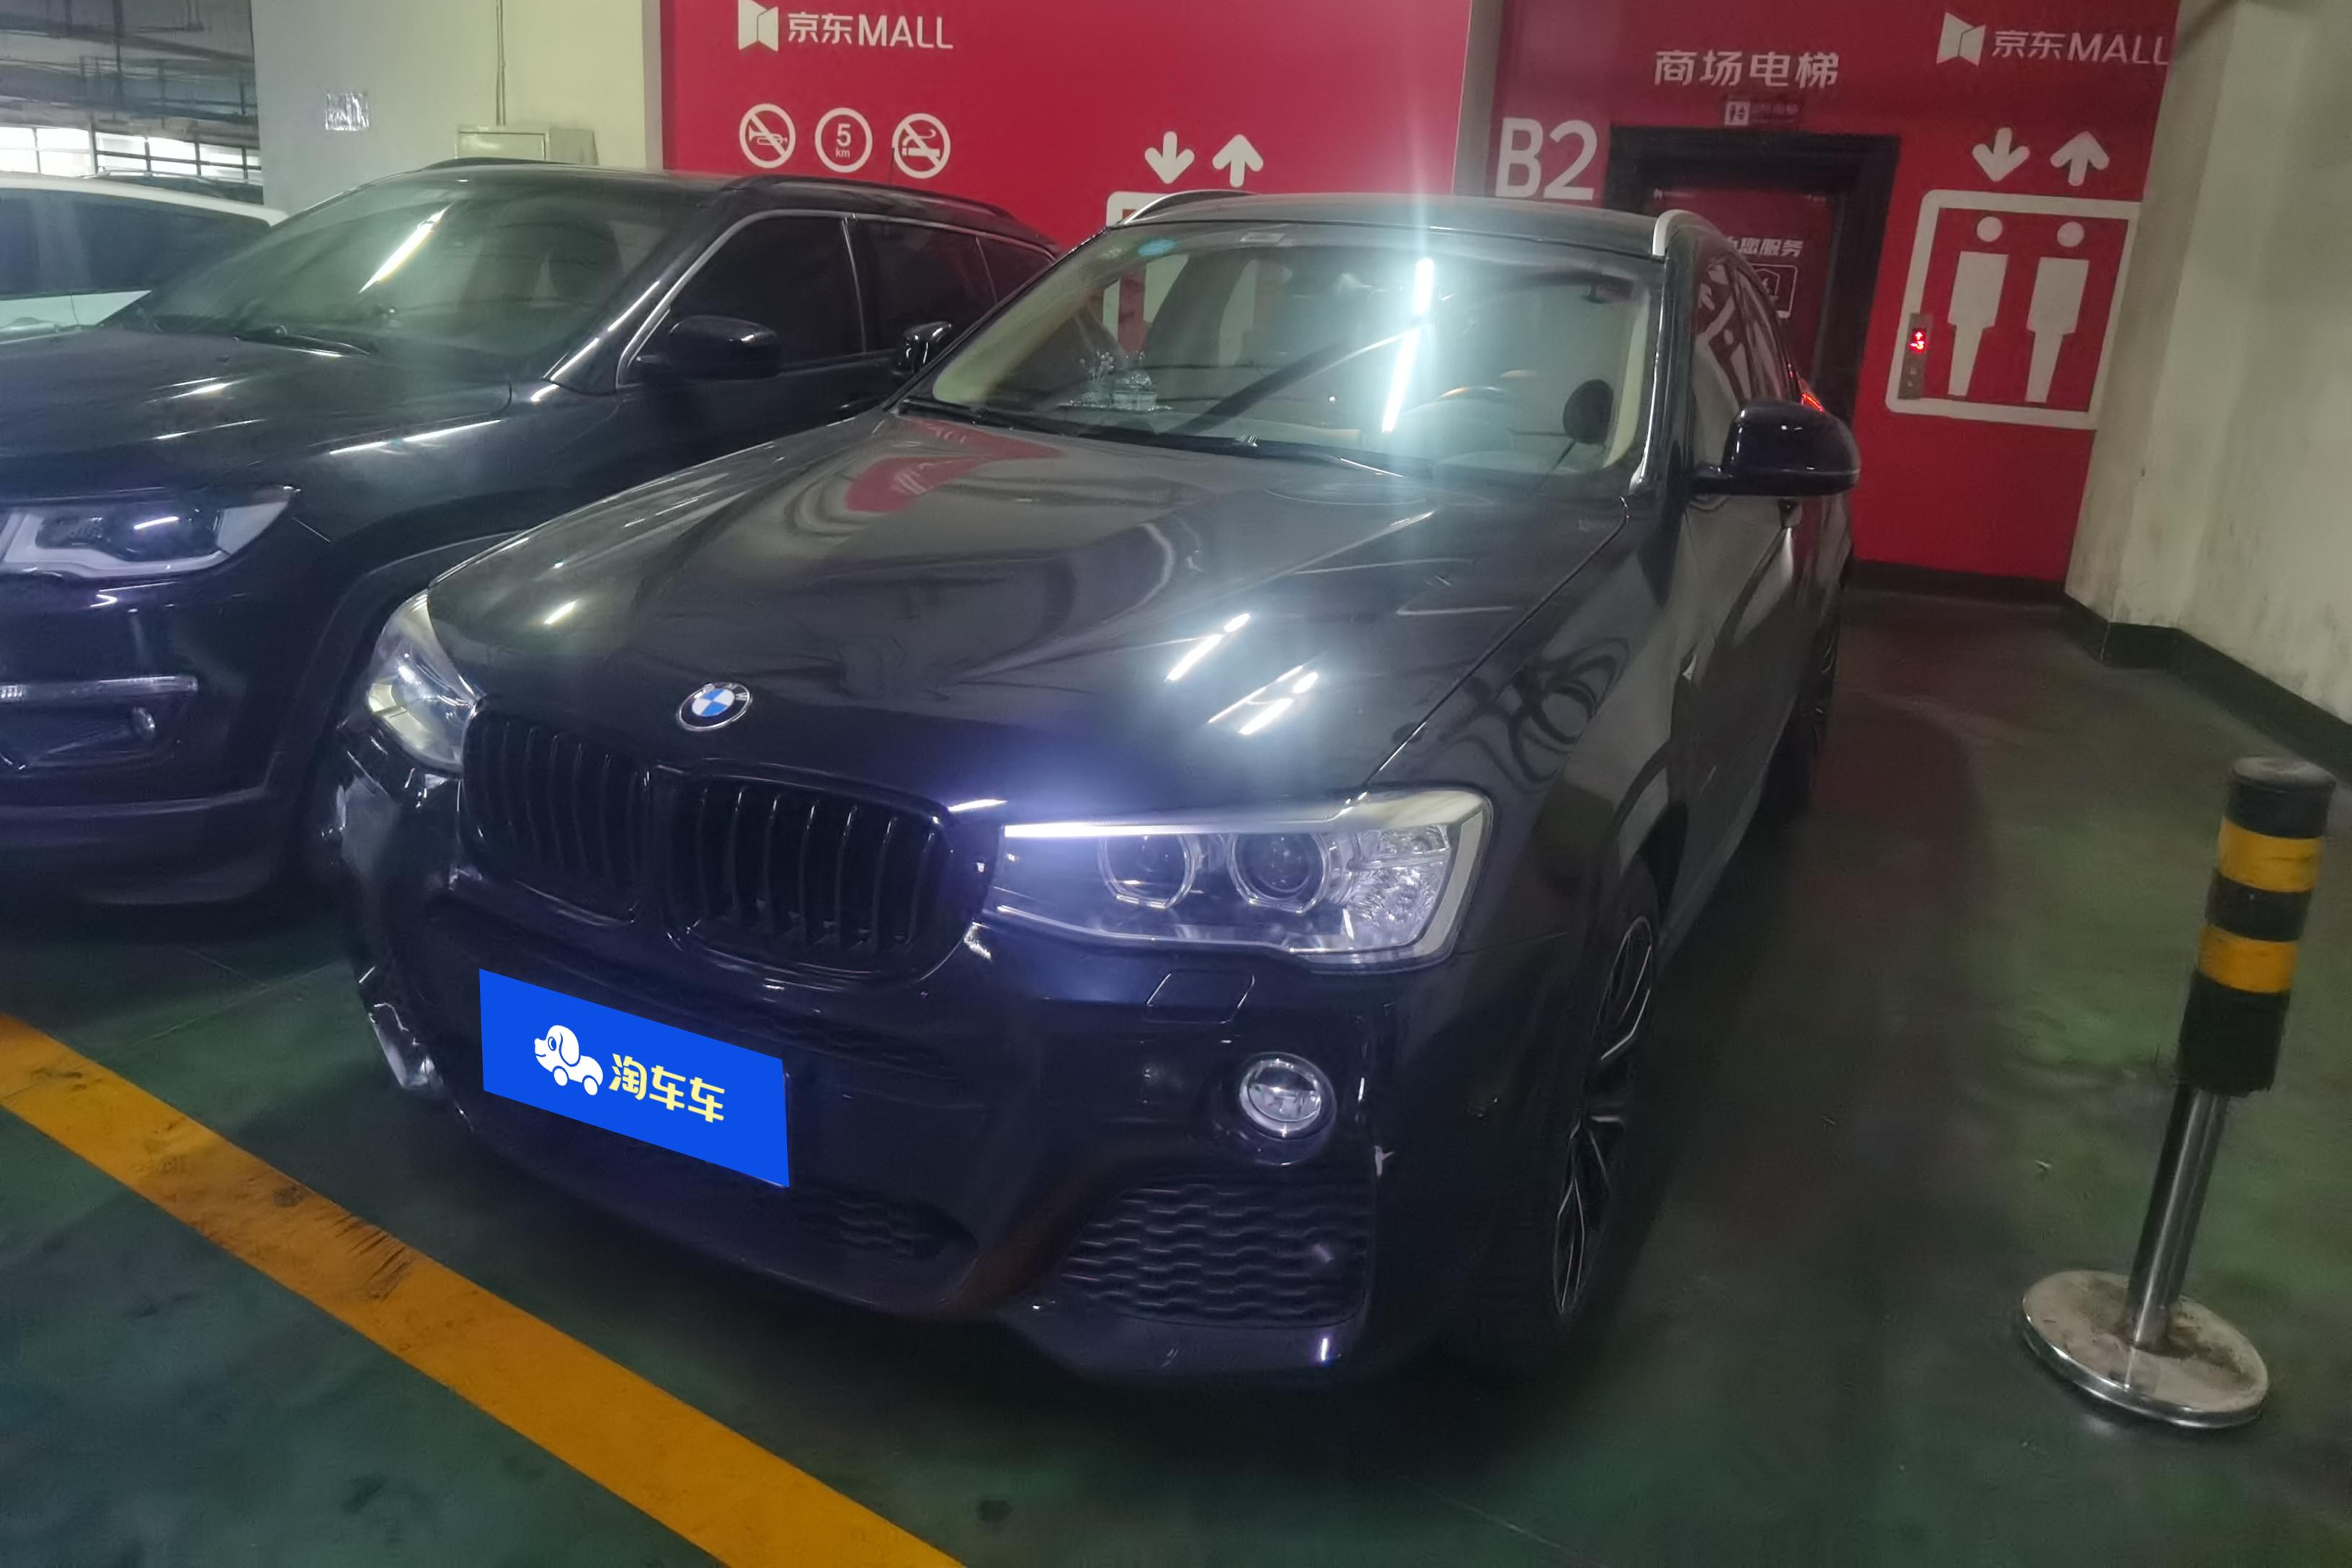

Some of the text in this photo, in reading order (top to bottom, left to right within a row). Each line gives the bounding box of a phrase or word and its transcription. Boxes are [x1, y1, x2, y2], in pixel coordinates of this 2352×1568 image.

[788, 12, 954, 49] 京东MALL
[1991, 30, 2169, 66] 京东MALL
[1654, 49, 1839, 89] 商场电梯
[836, 147, 850, 158] km
[837, 122, 852, 147] 5
[1495, 117, 1598, 201] B2
